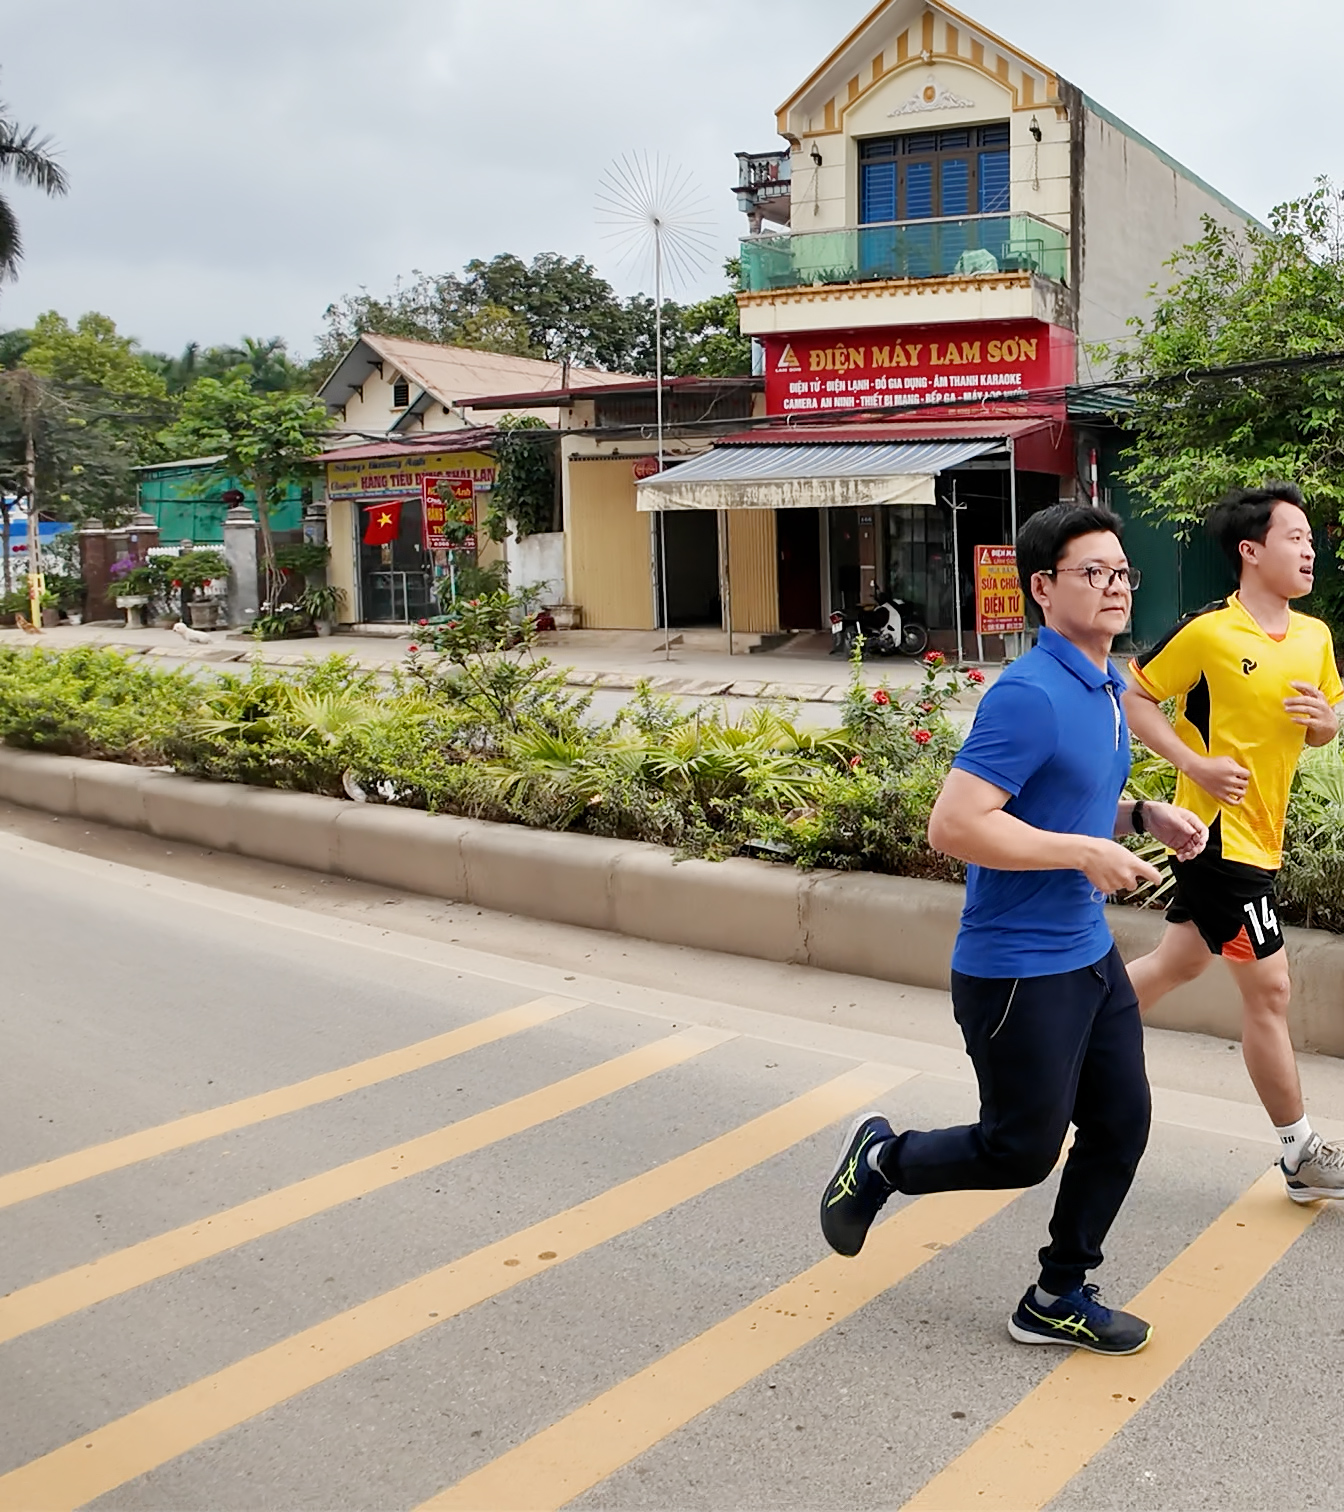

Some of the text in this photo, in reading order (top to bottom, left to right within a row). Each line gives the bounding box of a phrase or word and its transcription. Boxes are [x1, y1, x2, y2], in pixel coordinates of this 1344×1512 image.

[809, 336, 1038, 374] ĐIỆN MÁY LAM SƠN
[789, 380, 808, 395] ĐIỆN
[810, 376, 821, 392] TỬ
[826, 378, 846, 394] ĐIỆN
[847, 379, 869, 393] LẠNH
[888, 378, 903, 389] GIA
[904, 376, 928, 390] DỤNG
[949, 374, 979, 387] THANH
[980, 373, 1022, 386] KARAOKE
[783, 397, 818, 410] CAMERA
[820, 397, 832, 408] AN
[833, 396, 855, 407] NINH
[860, 391, 883, 407] THIẾT
[943, 392, 956, 403] GA
[474, 468, 496, 482] LAN
[981, 574, 998, 590] SỬA
[984, 590, 1021, 616] ĐIỆN TỬ
[1243, 895, 1280, 946] 14
